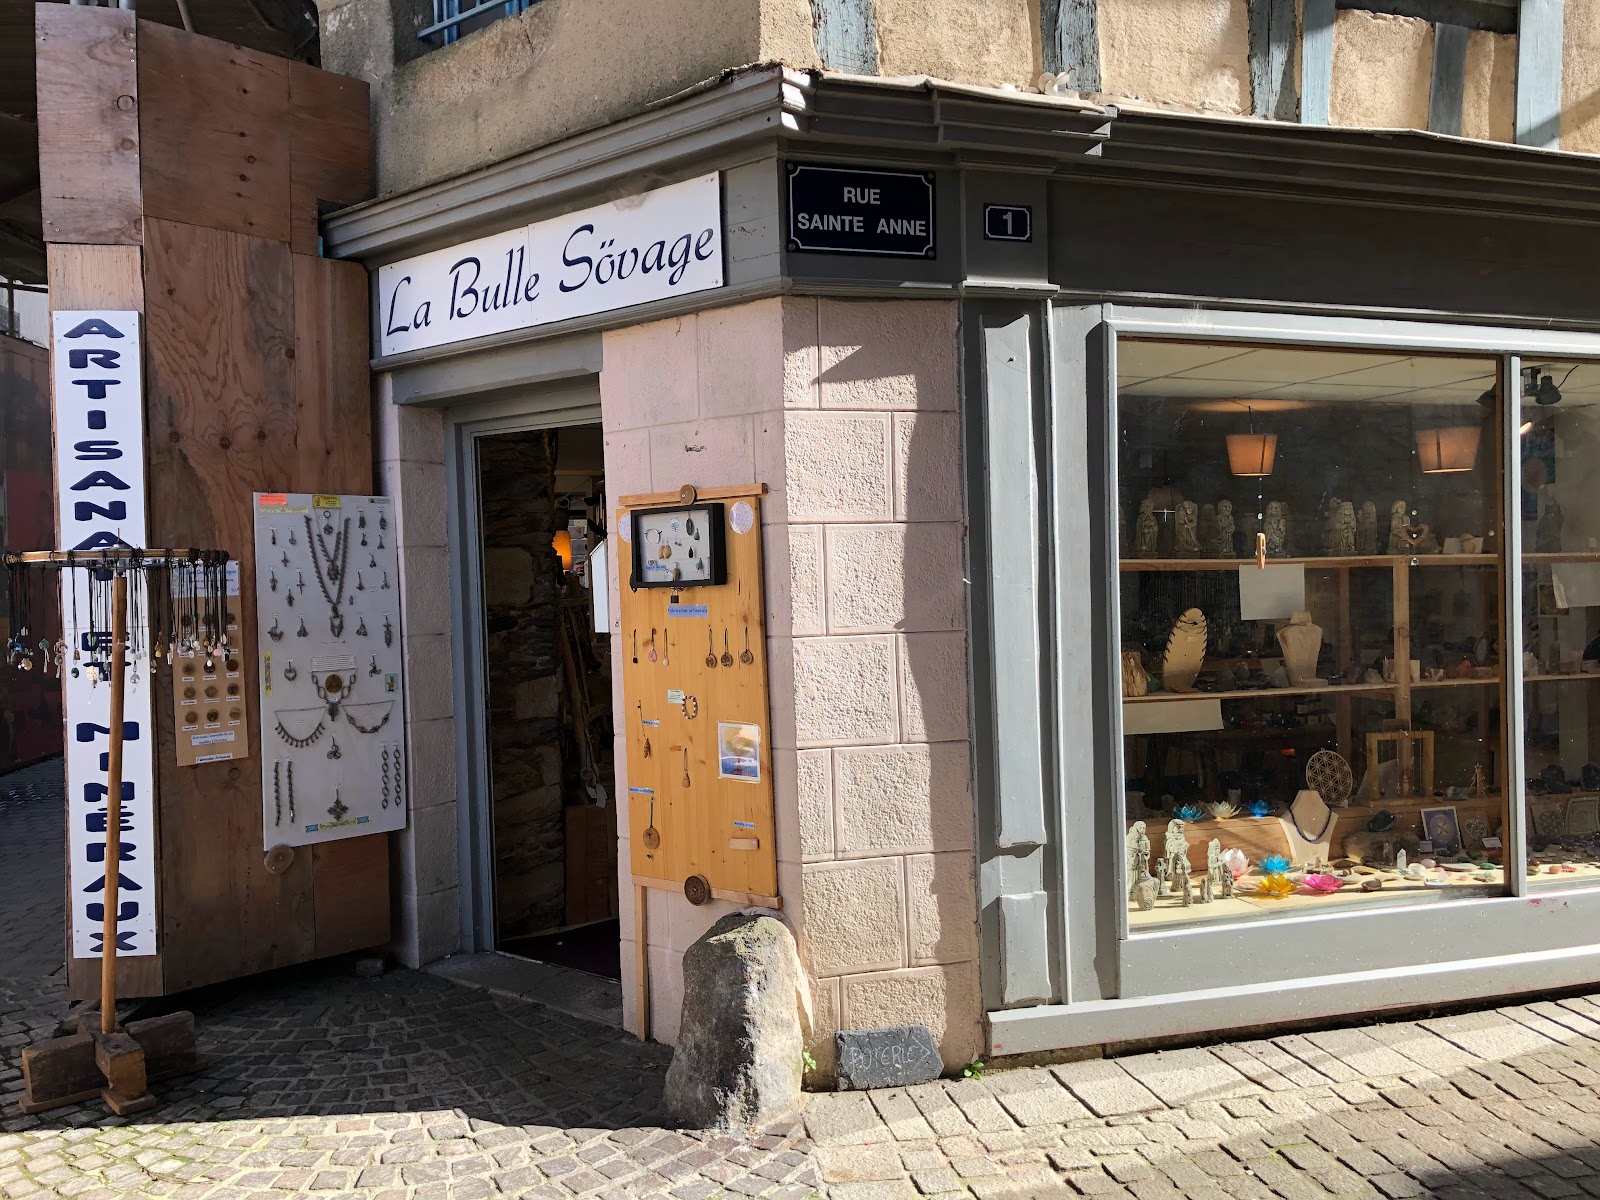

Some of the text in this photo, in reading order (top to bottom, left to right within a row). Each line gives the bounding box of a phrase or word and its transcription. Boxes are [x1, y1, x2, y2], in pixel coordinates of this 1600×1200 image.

[843, 186, 881, 205] RUE
[797, 212, 927, 237] SAINTE ANNE
[1002, 211, 1013, 235] 1
[386, 223, 714, 336] La Bulle Sövage
